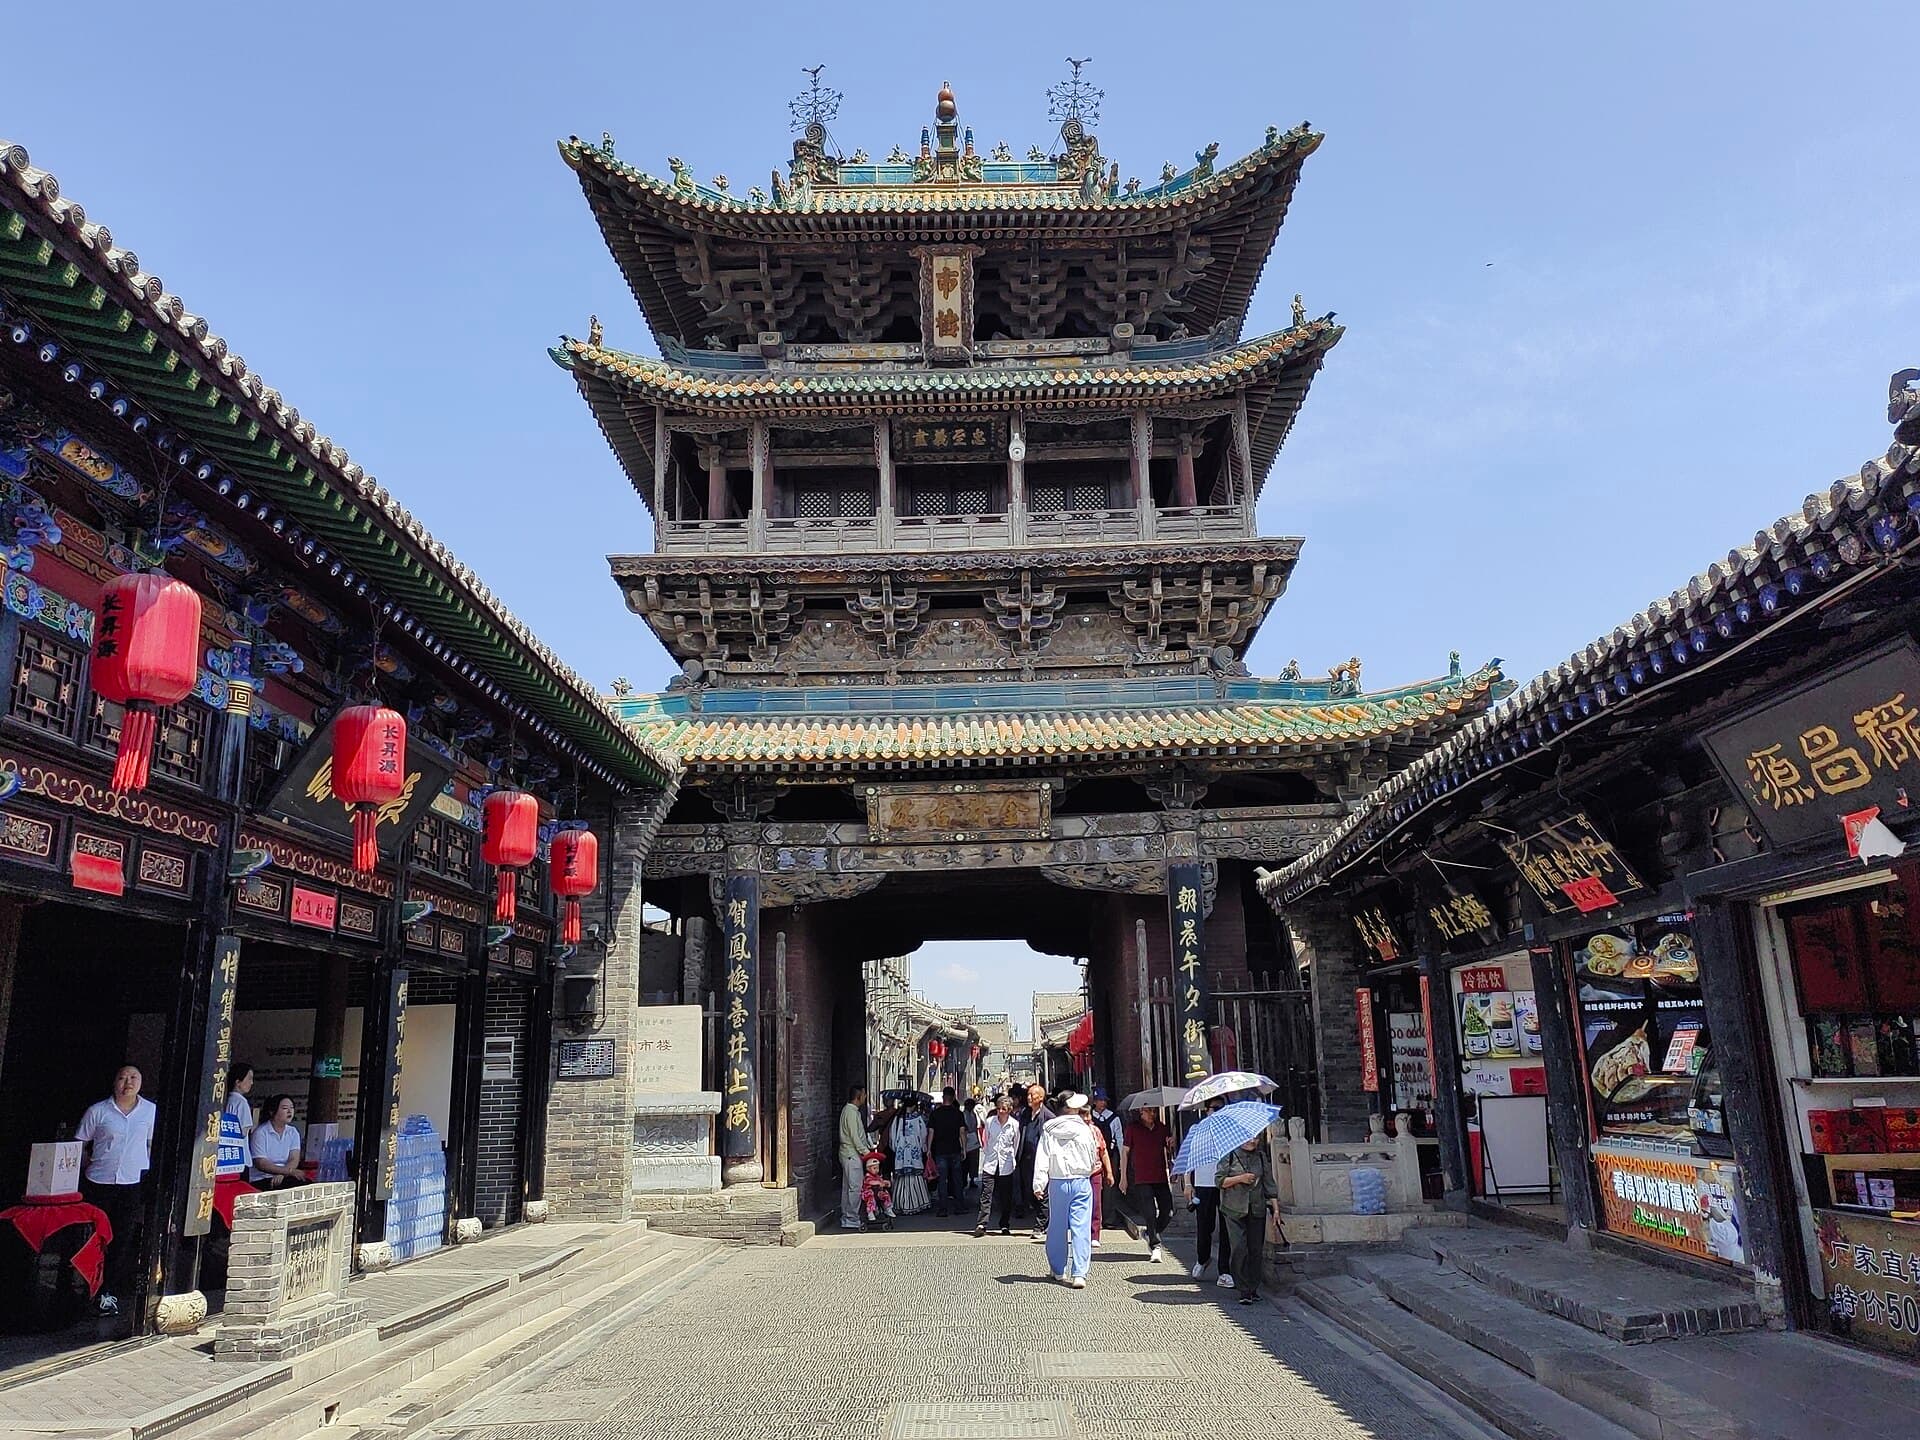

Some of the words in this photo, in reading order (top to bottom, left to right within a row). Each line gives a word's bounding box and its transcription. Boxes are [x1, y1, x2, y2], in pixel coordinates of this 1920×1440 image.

[378, 724, 399, 774] 长昇源
[1463, 970, 1502, 990] 冷热饮
[637, 1039, 673, 1052] 市楼
[1613, 1170, 1700, 1216] 看得见的新疆味
